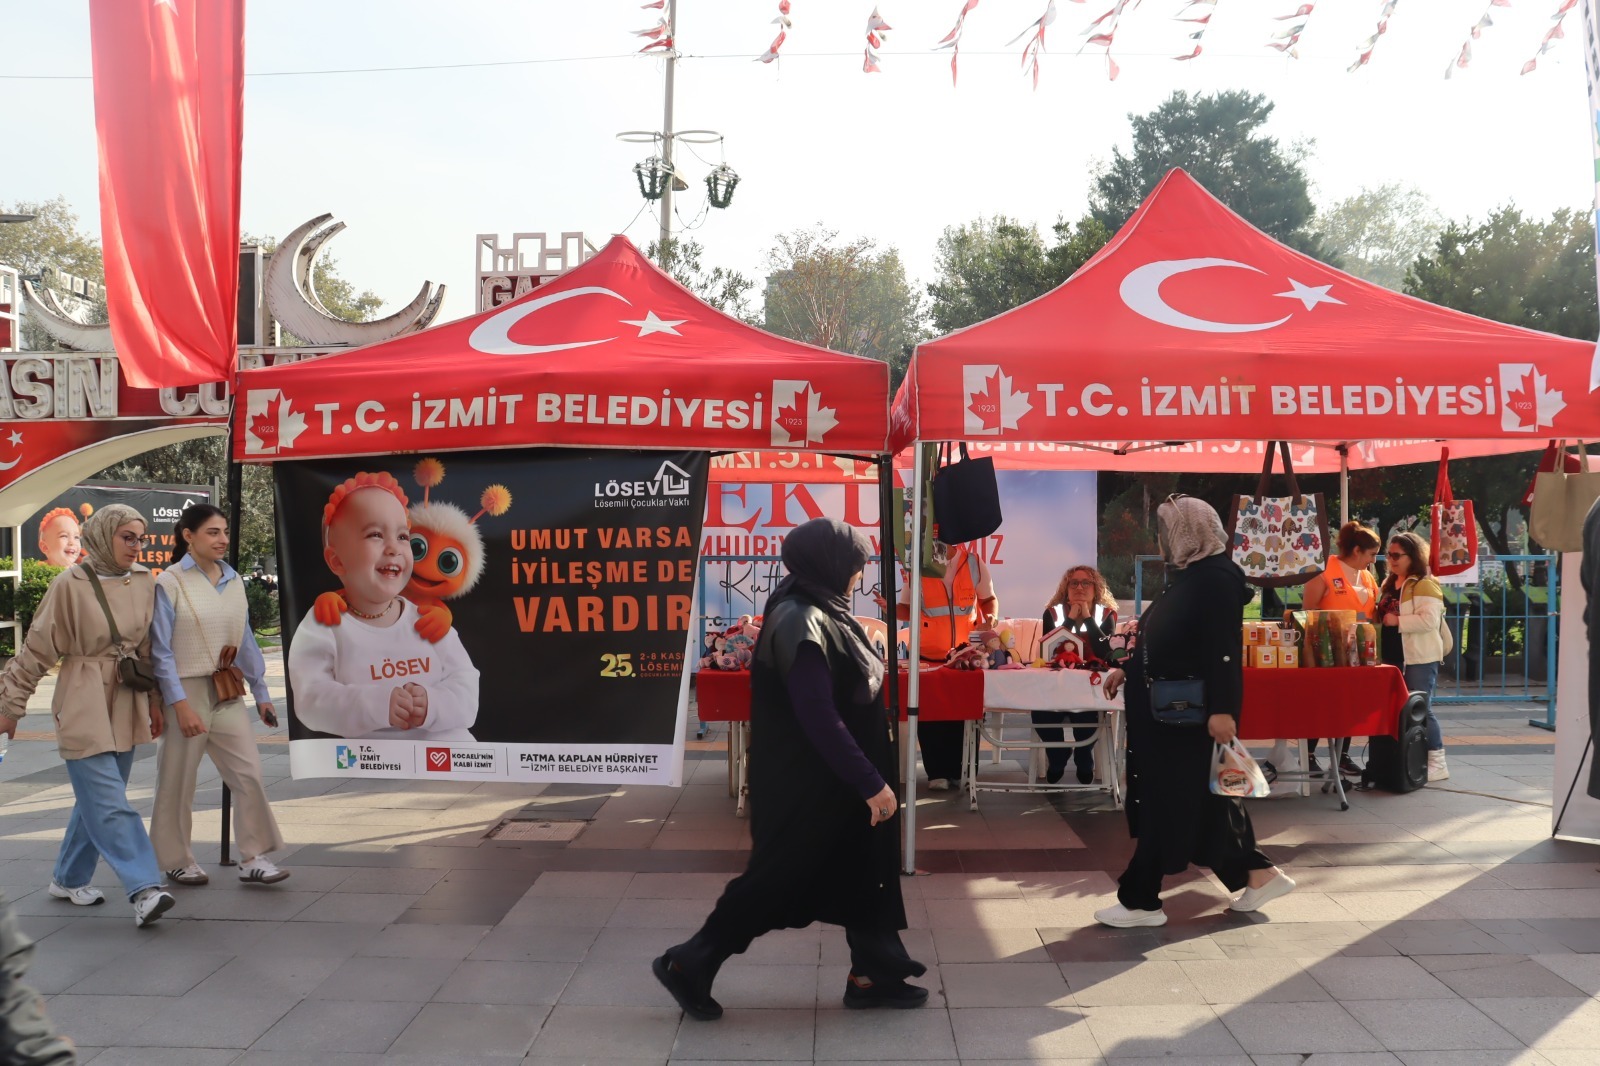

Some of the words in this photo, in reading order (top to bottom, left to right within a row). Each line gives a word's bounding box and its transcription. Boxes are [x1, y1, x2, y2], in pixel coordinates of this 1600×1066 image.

[1036, 382, 1129, 417] T.C.
[1140, 376, 1256, 416] İZMİT
[1271, 376, 1496, 415] BELEDİYESİ
[314, 400, 399, 435] T.C.
[411, 387, 523, 430] İZMİT
[536, 388, 763, 430] BELEDİYESİ
[977, 404, 996, 413] 1923
[1514, 401, 1532, 410] 1923
[784, 418, 803, 426] 1923
[257, 425, 275, 433] 1923
[594, 480, 660, 498] LÖSEV
[594, 498, 629, 508] Lösemili
[630, 498, 667, 509] Çocuklar
[668, 497, 690, 507] Vakfı
[510, 528, 588, 551] UMUT
[597, 526, 692, 549] VARSA
[511, 557, 648, 590] İYİLEŞME
[657, 560, 692, 582] DE
[512, 594, 692, 633] VARDIR
[640, 652, 657, 661] 2-8
[370, 657, 430, 681] LÖSEV
[600, 653, 637, 678] 25.
[359, 745, 374, 753] T.C.
[359, 754, 381, 762] İZMİT
[520, 753, 556, 763] FATMA
[558, 754, 602, 763] KAPLAN
[605, 752, 659, 764] HÜRRİYET
[360, 762, 402, 771] BELEDİYESİ
[558, 763, 604, 773] BELEDİYE
[606, 764, 649, 774] BAŞKANI
